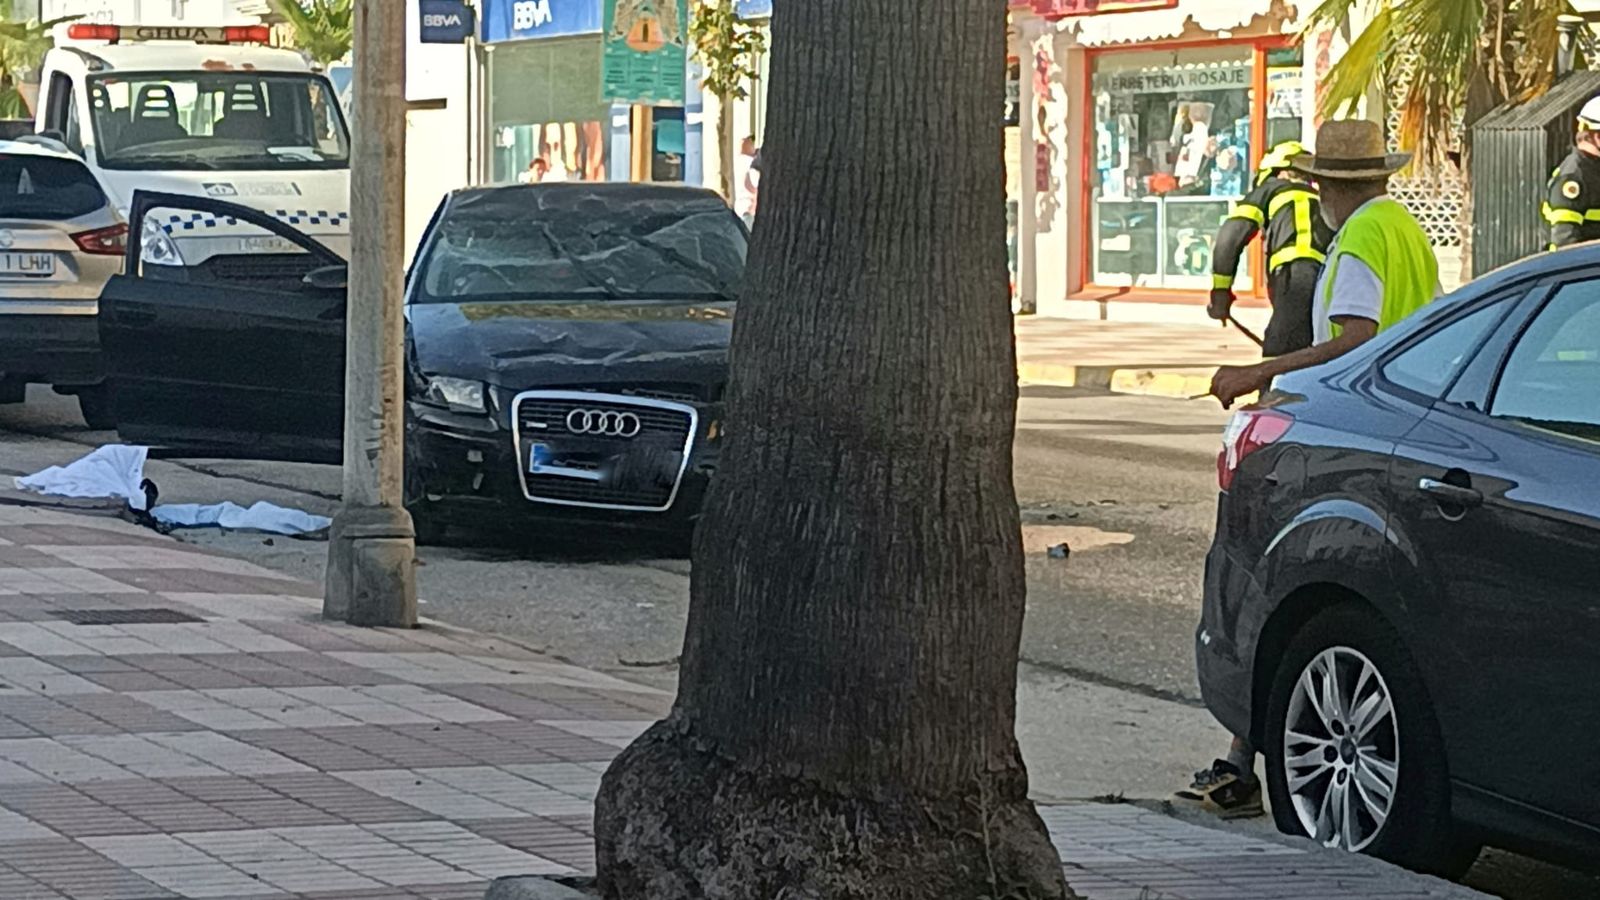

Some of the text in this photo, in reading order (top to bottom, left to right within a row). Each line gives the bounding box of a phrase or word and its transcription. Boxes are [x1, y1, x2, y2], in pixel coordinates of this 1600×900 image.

[424, 14, 461, 27] BBVA
[513, 0, 552, 30] BBVA
[1104, 69, 1244, 91] ERRETERIA ROSAJE
